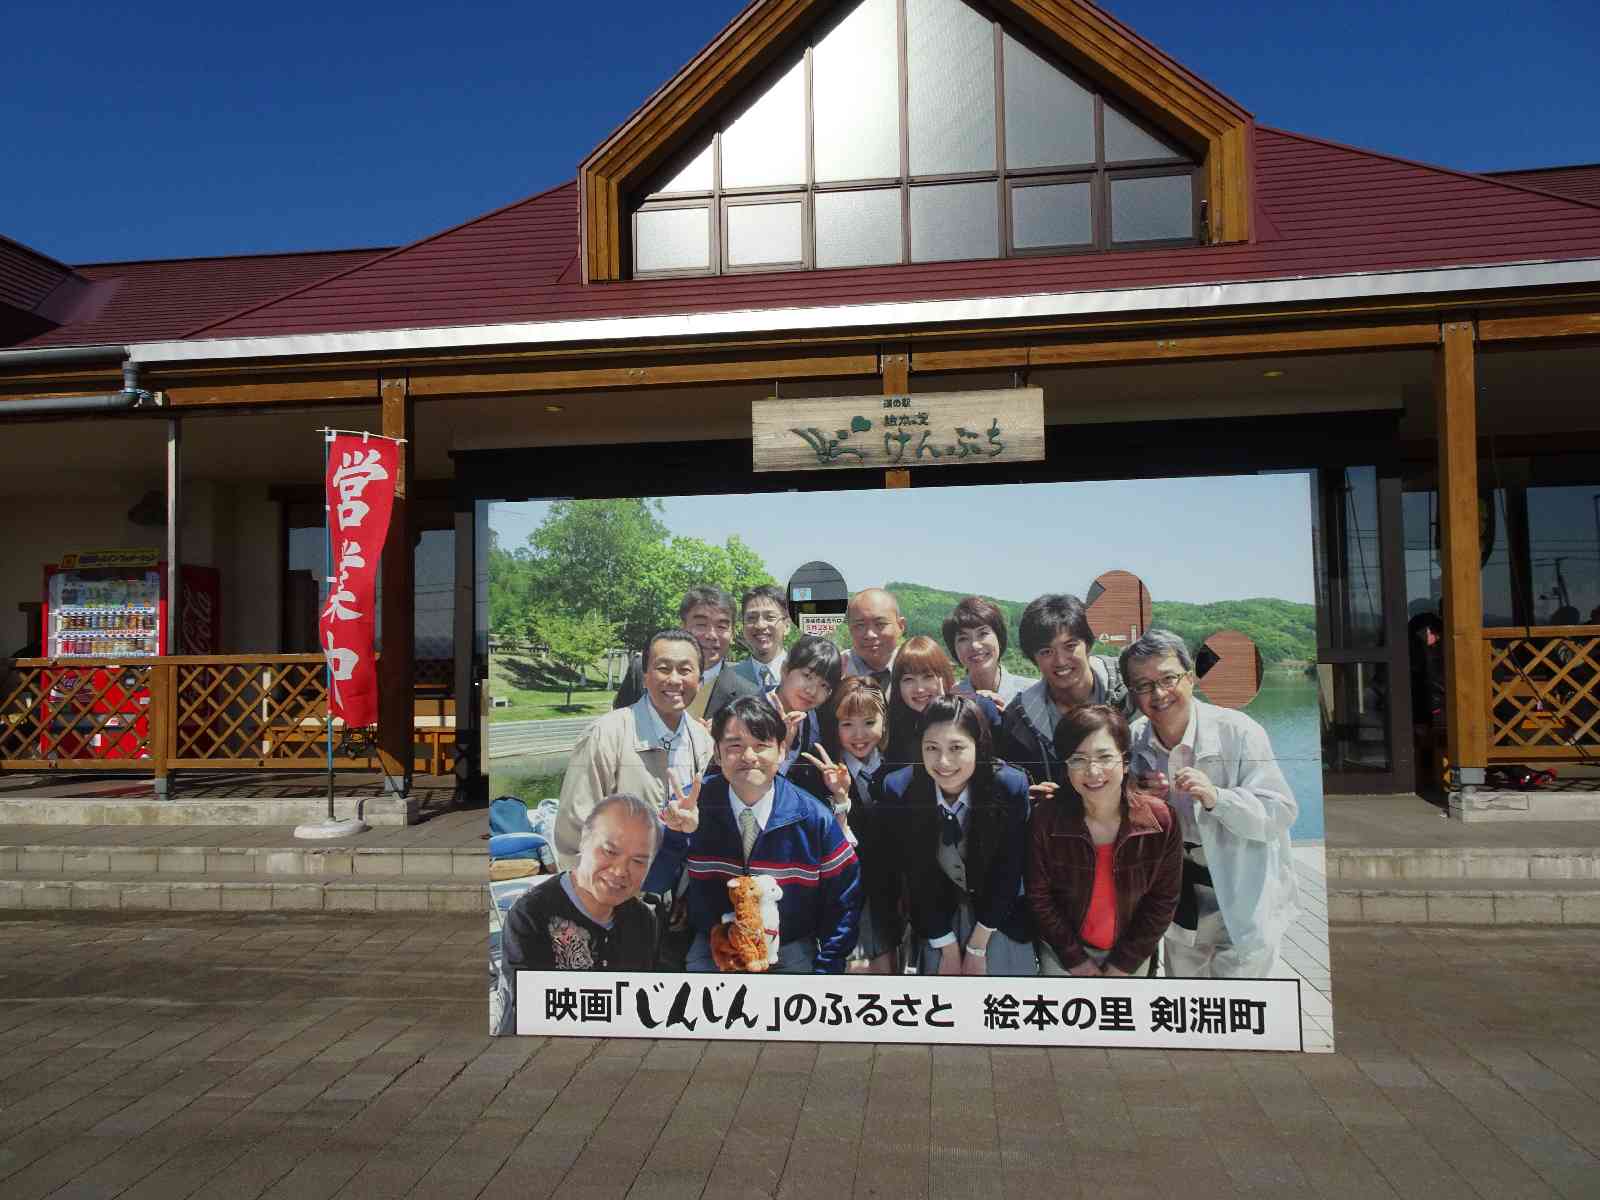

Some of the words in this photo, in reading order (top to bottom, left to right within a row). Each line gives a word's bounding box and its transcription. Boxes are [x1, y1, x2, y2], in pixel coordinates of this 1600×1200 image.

[321, 449, 389, 710] 営業中
[545, 981, 956, 1032] 映画「じんじん」のふるさと
[983, 993, 1136, 1032] 絵本の里
[1149, 996, 1267, 1035] 剣淵町
